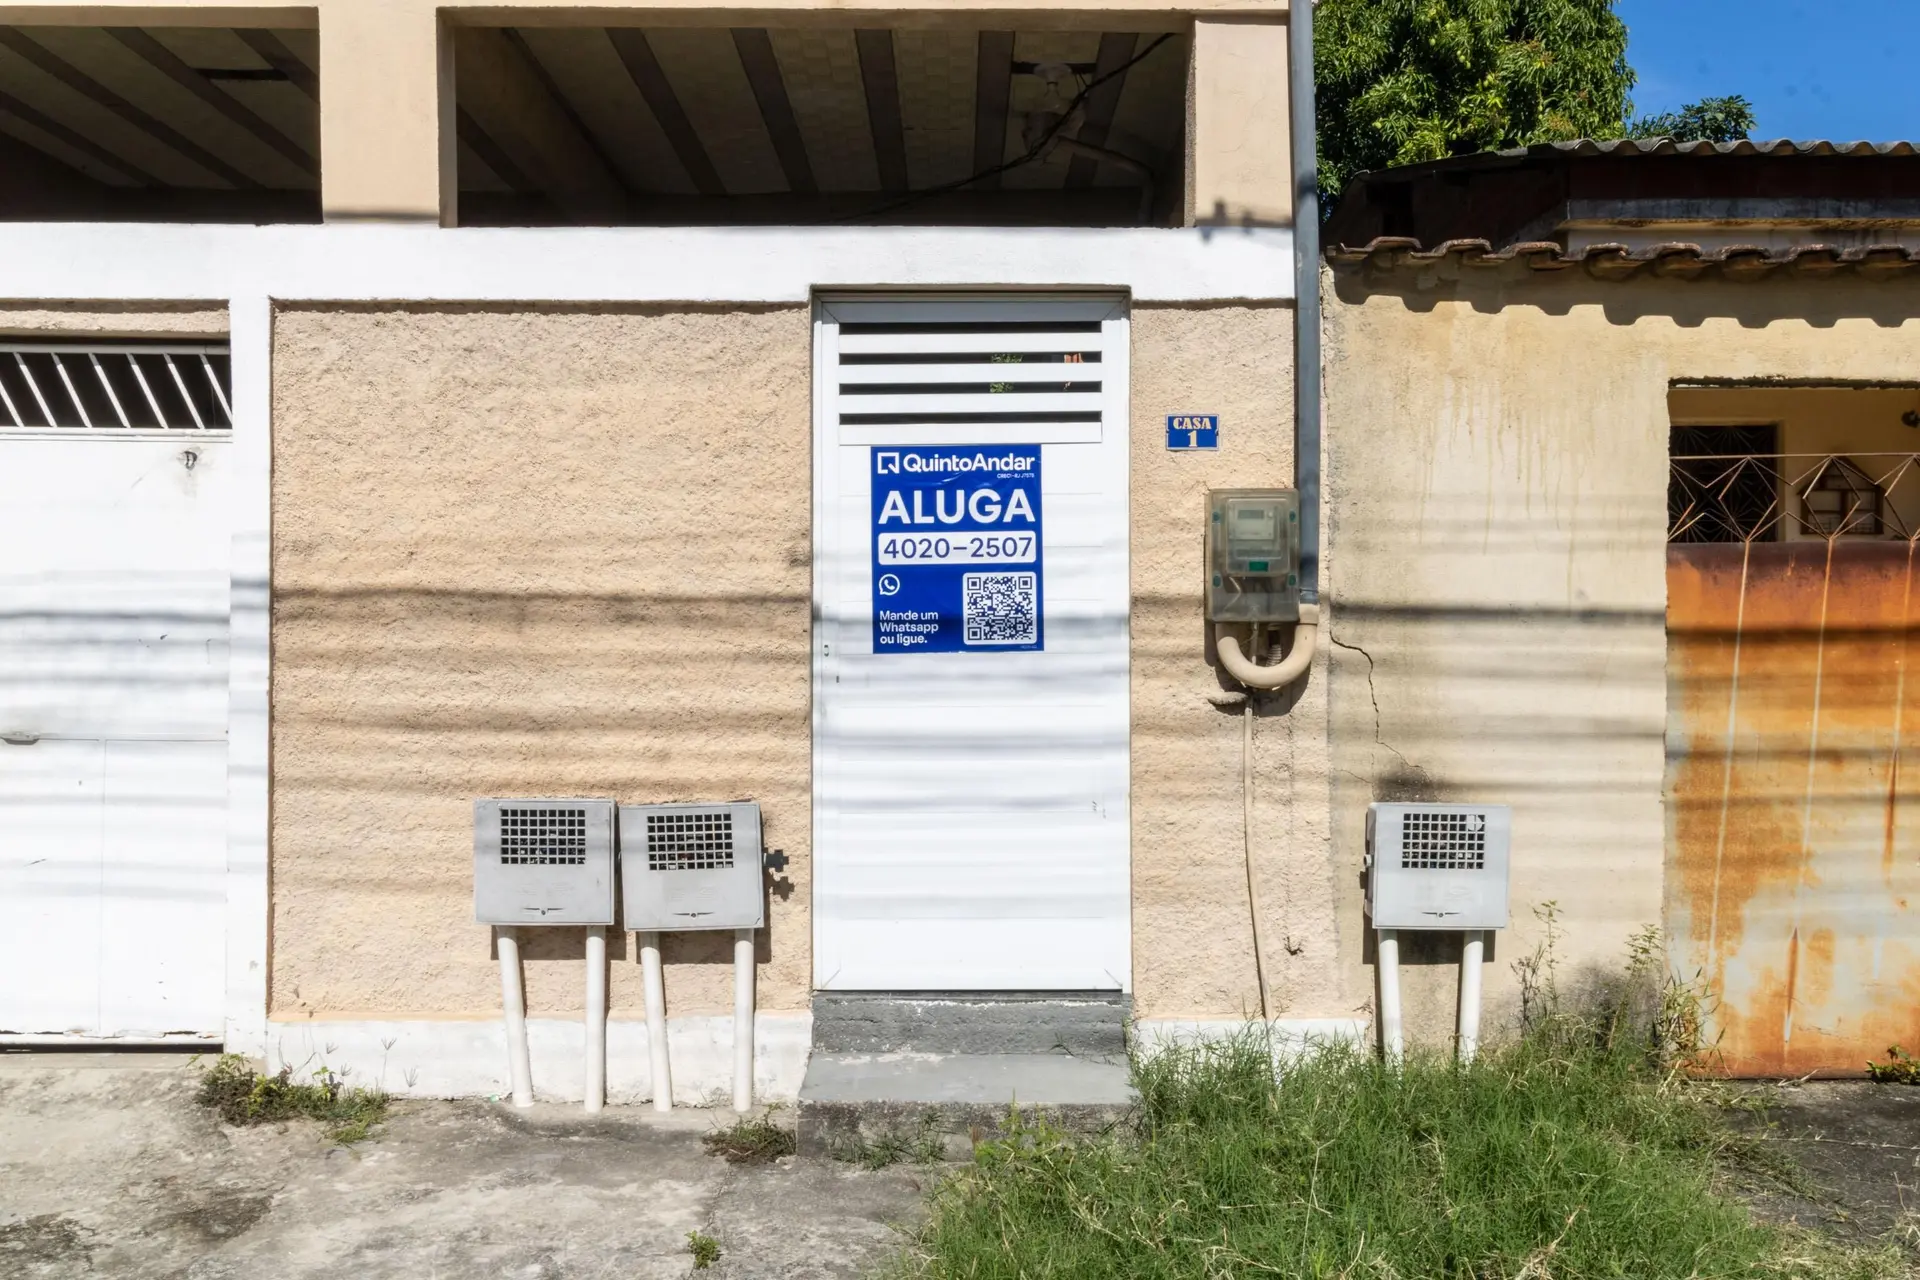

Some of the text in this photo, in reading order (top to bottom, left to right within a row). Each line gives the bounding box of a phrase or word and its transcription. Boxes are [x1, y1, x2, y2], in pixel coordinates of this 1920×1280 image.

[1173, 417, 1212, 429] CASA
[1187, 430, 1198, 448] 1
[903, 453, 1035, 473] QuintoAndar
[878, 488, 1036, 524] ALUGA
[883, 537, 1033, 559] 4020-2507
[879, 610, 939, 620] Mande um
[879, 622, 939, 634] Whatsapp
[880, 633, 928, 646] ou ligue.
